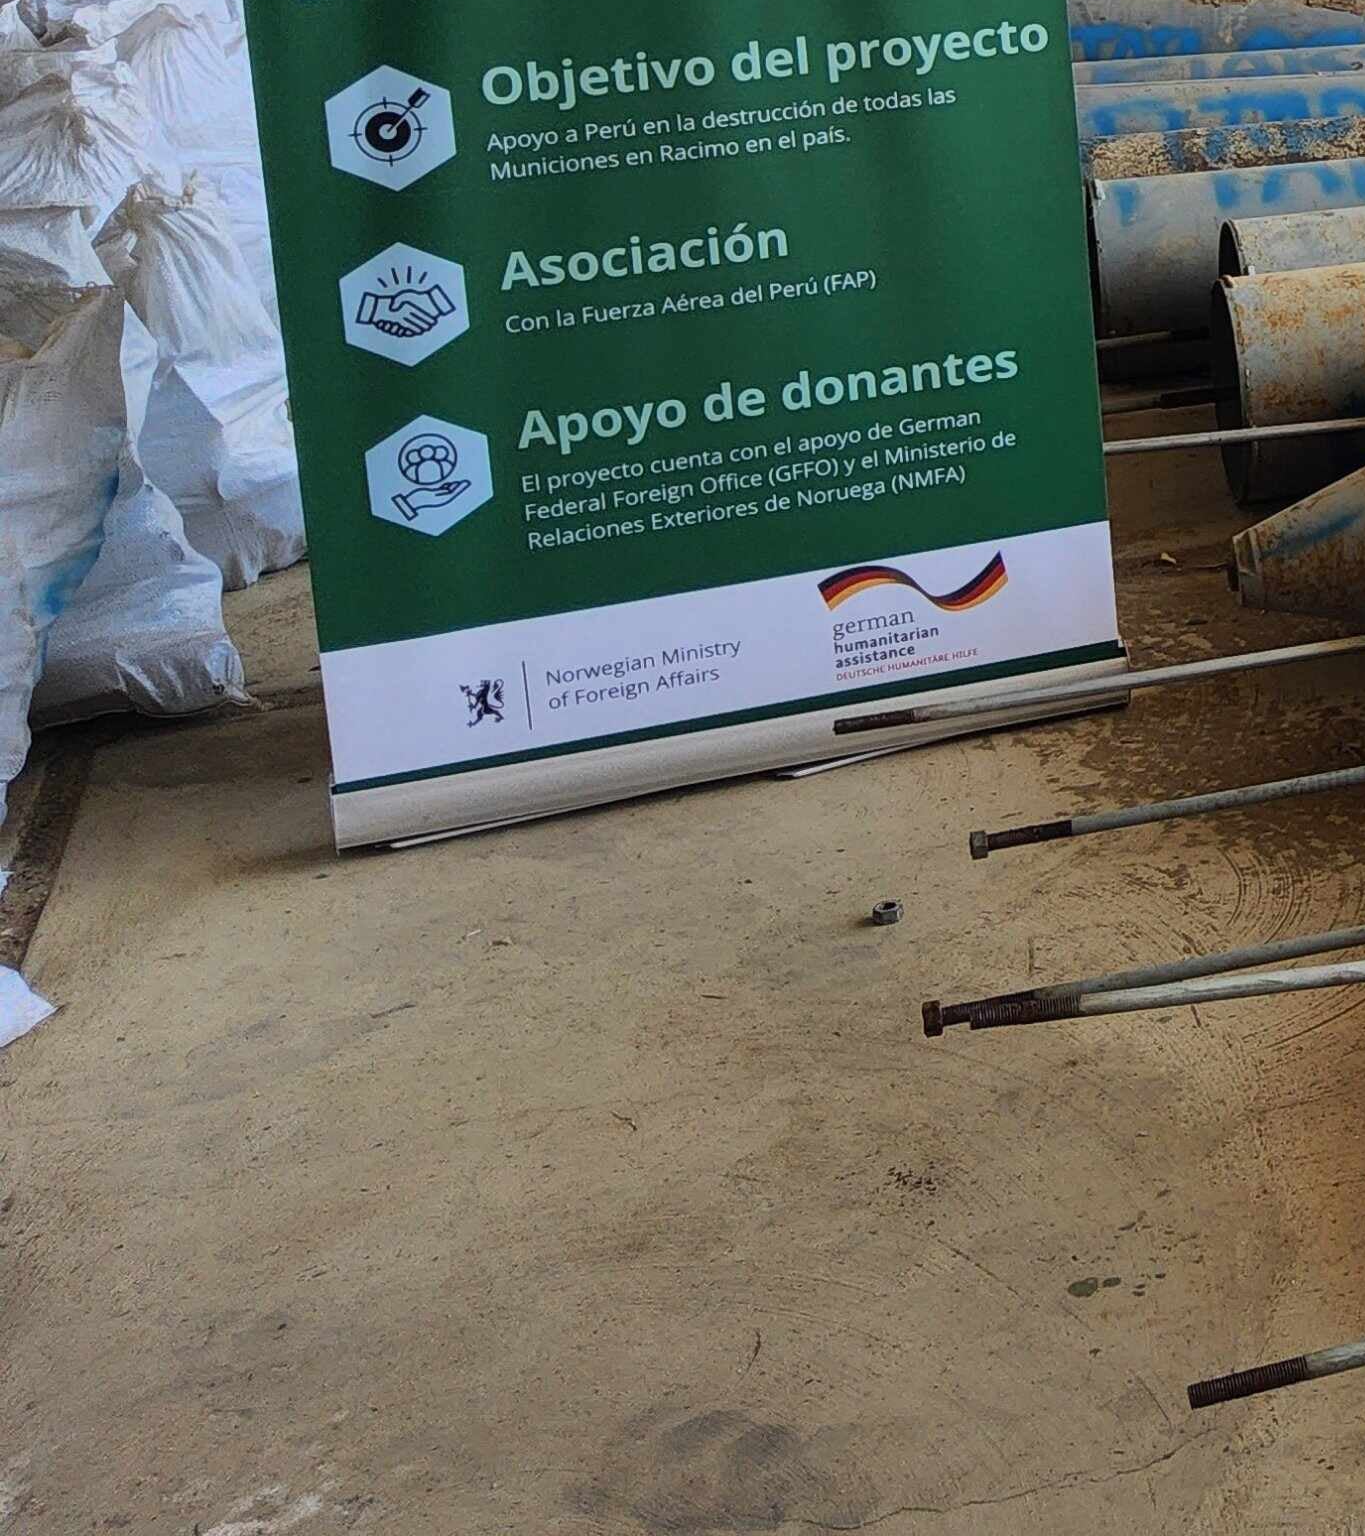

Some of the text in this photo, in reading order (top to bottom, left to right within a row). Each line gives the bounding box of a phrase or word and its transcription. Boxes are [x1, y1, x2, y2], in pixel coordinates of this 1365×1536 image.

[481, 50, 715, 111] Objetivo
[730, 34, 809, 82] del
[825, 20, 1049, 84] proyecto
[486, 86, 956, 155] Apoyo a Perú en la destrucción de todas las
[489, 126, 851, 181] Municiones en Racimo en el país.
[500, 221, 788, 291] Asociación
[504, 268, 876, 333] Con la Fuerza Aérea del Perú (FAP)
[517, 349, 1018, 454] Apoyo de donantes
[520, 411, 981, 495] El proyecto cuenta con el apoyo de German
[524, 429, 1016, 522] Federal Foreign Office (GFFO) y el Ministerio de
[527, 464, 966, 550] Relaciones Exteriores de Noruega (NMFA)
[831, 610, 915, 642] german
[832, 626, 939, 655] humanitarian
[834, 644, 915, 669] assistance
[545, 639, 741, 686] Norwegian Ministry
[547, 667, 720, 710] of Foreign Affairs
